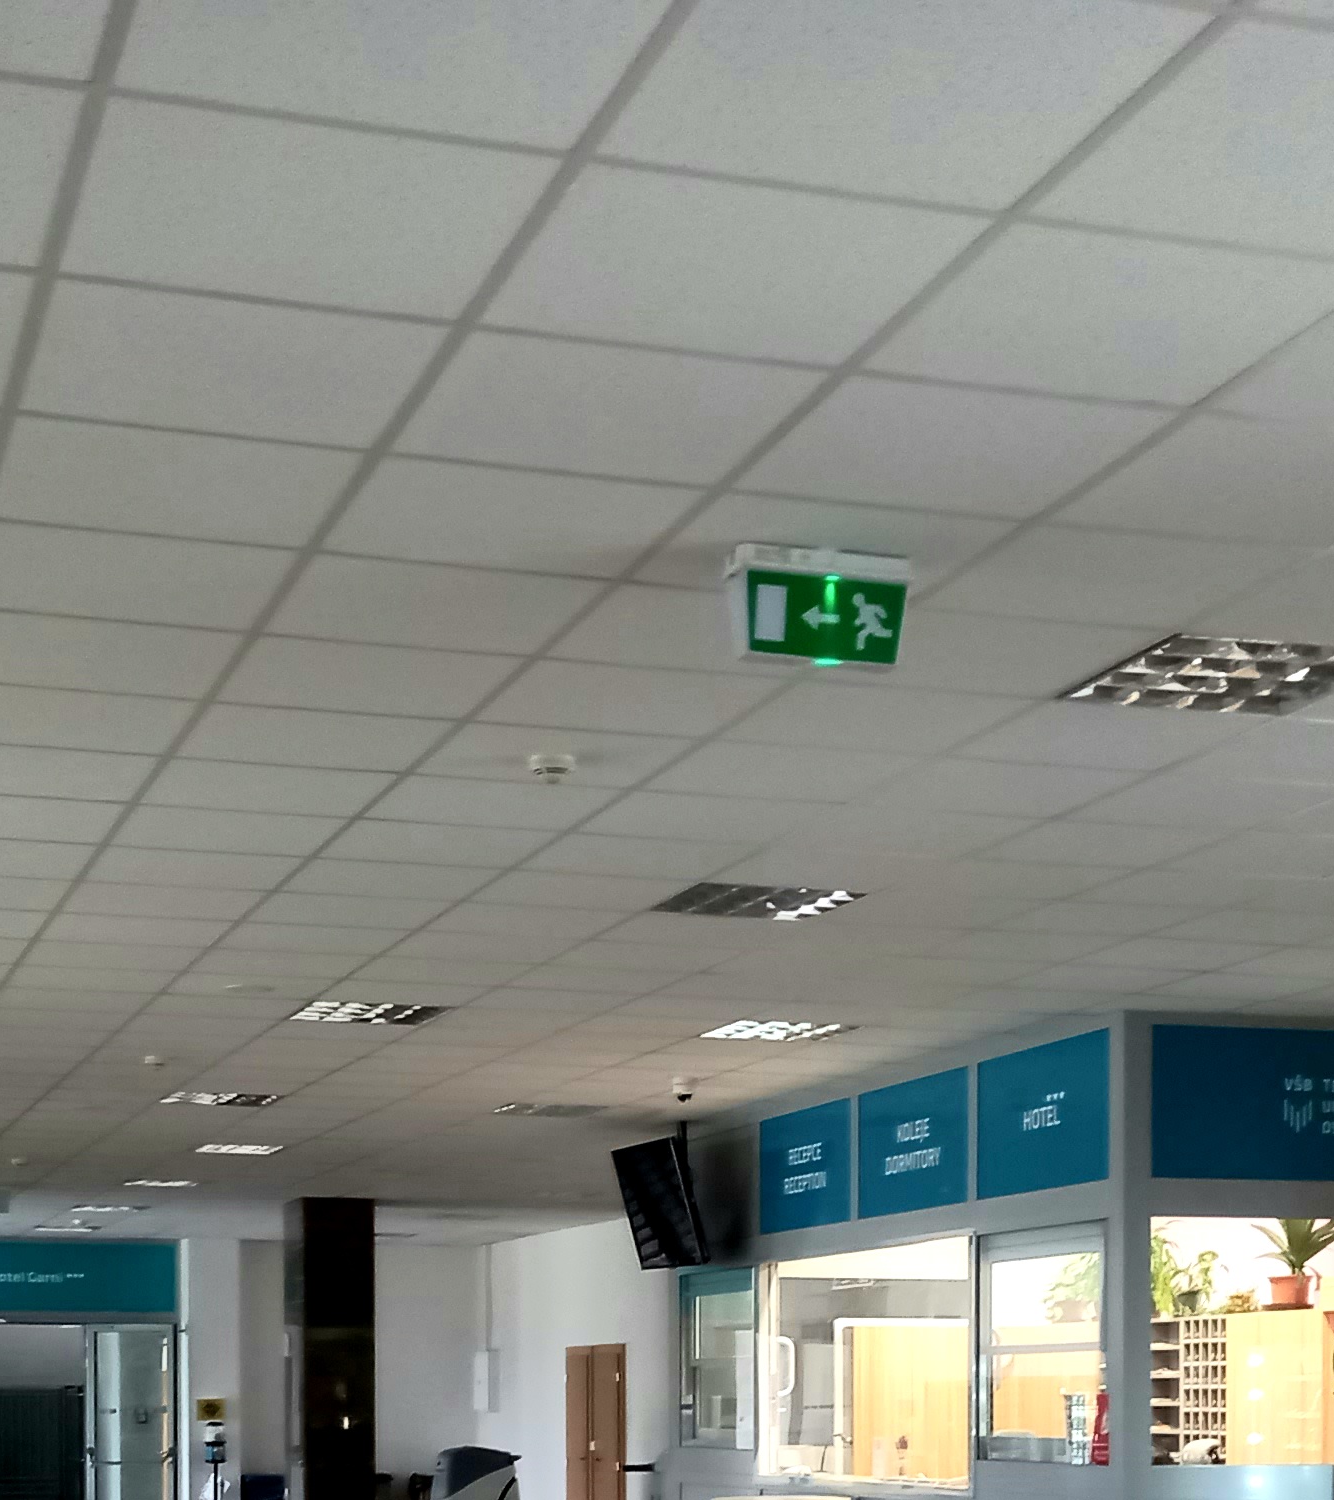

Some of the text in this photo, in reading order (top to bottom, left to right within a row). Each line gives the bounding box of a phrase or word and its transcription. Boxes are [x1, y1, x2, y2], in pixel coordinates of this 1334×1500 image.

[896, 1117, 930, 1143] KOLEJE
[1023, 1105, 1061, 1131] HOTEL
[788, 1142, 822, 1166] RECEPCE
[885, 1147, 941, 1176] DORMITORY
[784, 1171, 827, 1195] RECEPTION
